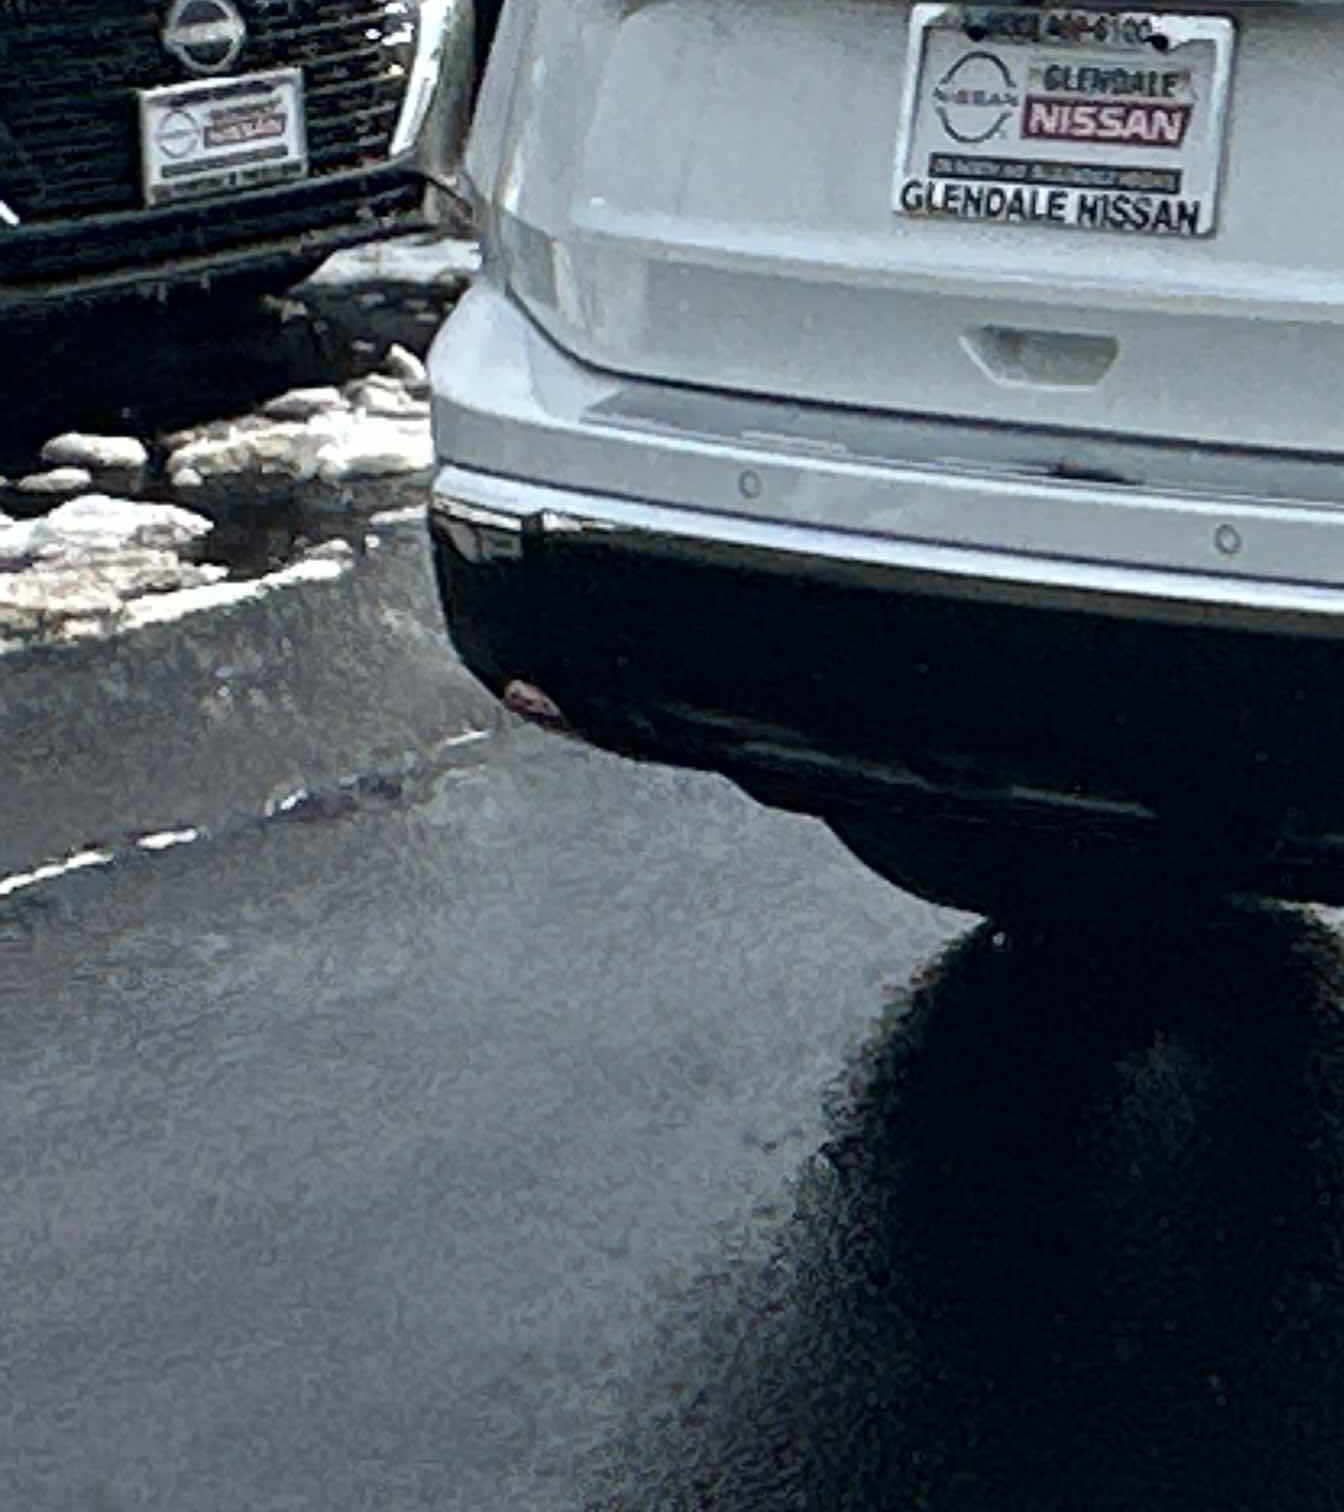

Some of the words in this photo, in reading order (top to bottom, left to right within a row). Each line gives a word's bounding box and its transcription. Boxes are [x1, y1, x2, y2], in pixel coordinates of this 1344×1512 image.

[1026, 103, 1184, 141] NISSAN
[900, 180, 1070, 222] GLENDALE
[1078, 188, 1201, 234] NISSAN
